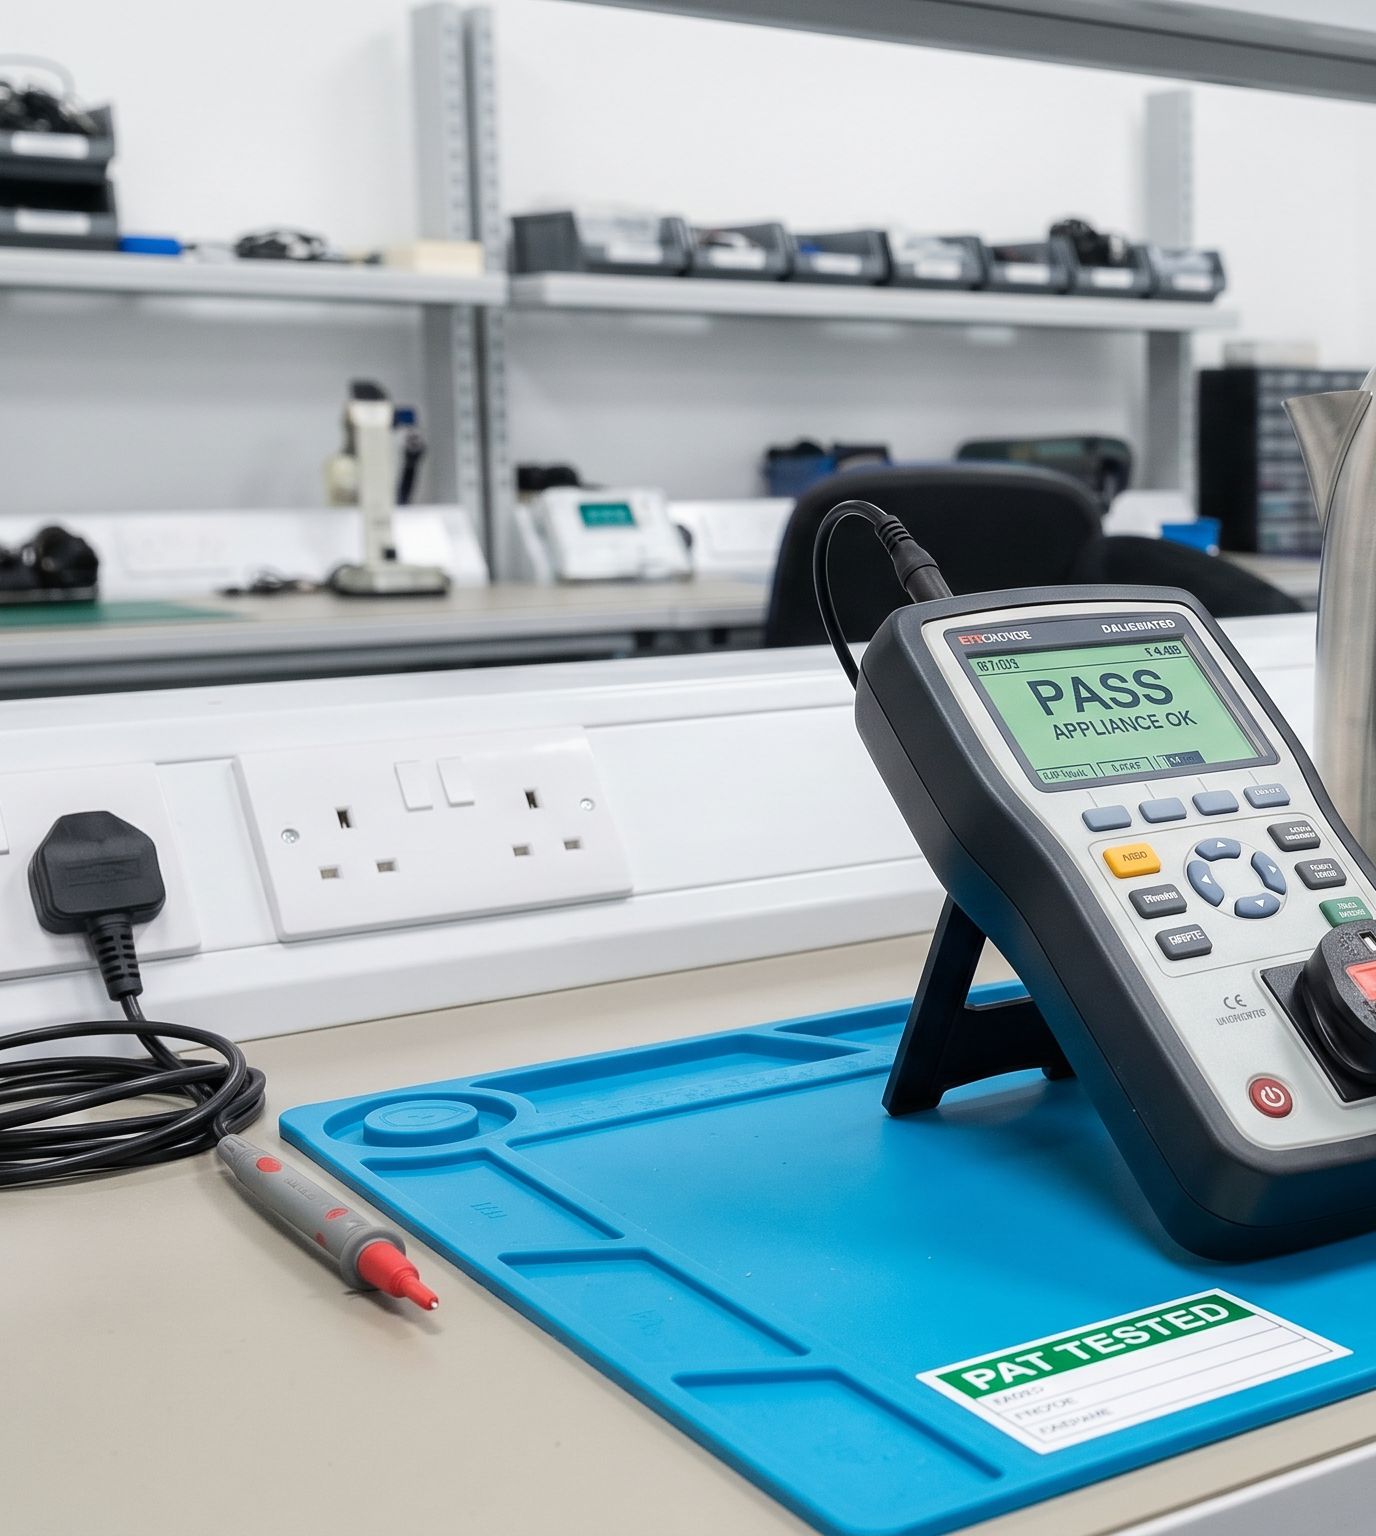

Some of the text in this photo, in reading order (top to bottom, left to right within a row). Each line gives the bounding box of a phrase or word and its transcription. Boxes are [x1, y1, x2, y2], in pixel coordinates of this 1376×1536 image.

[1026, 669, 1174, 716] PASS
[1053, 710, 1198, 740] APPLIANCE OK
[961, 1303, 1230, 1391] PAT TESTED
